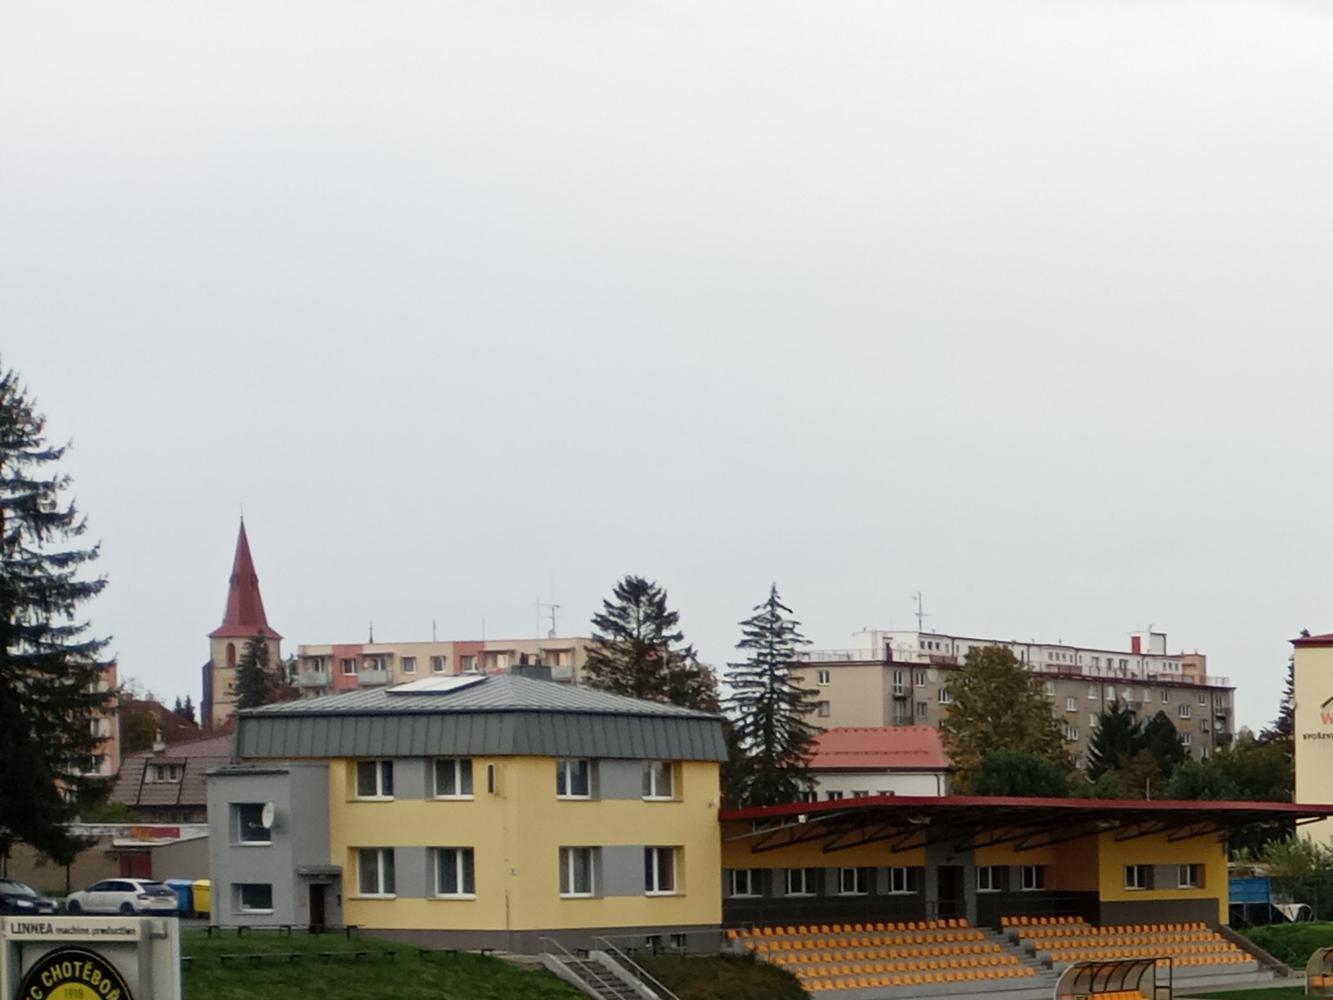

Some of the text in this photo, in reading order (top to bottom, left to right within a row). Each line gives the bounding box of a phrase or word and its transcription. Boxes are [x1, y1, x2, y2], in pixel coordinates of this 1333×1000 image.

[10, 922, 137, 937] LINNEA machine production
